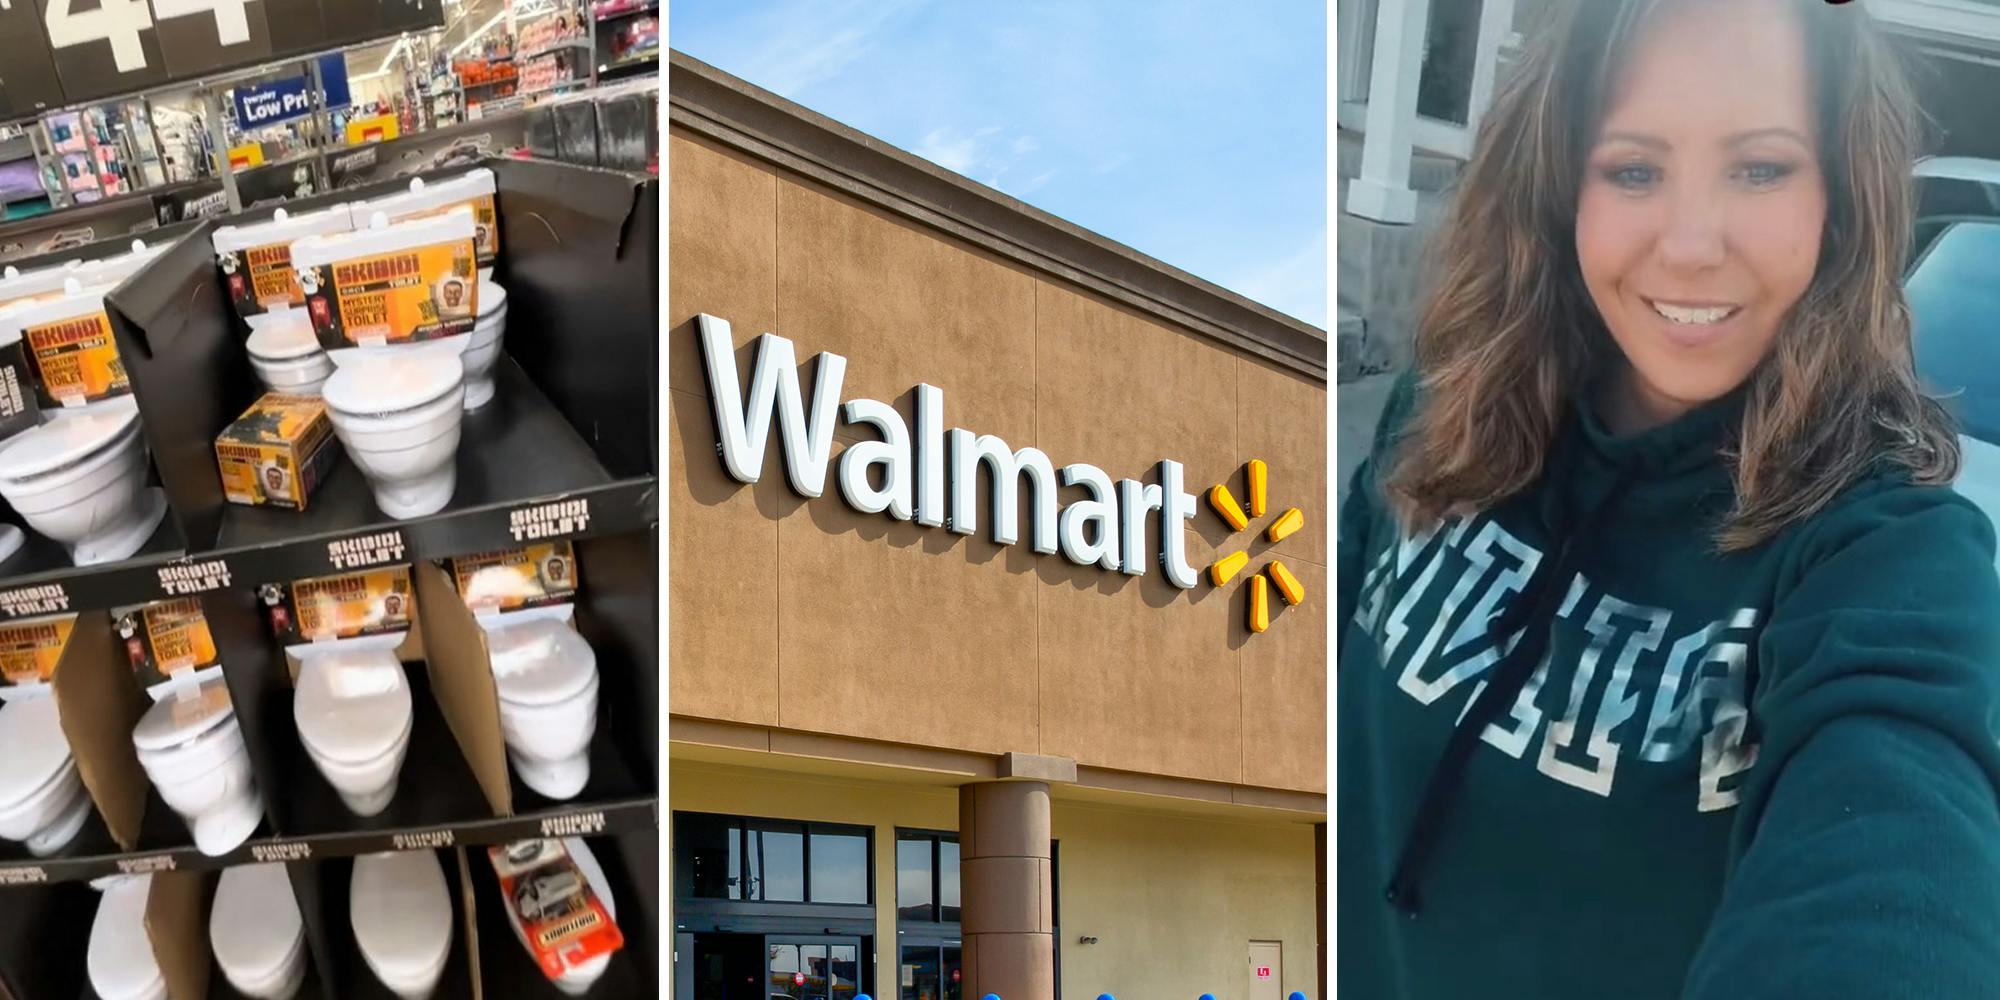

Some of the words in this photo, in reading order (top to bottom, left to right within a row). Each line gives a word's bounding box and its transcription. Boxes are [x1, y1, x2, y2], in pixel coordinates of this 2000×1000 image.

[246, 101, 280, 122] Low
[283, 89, 327, 112] Pri
[249, 245, 291, 266] SKIB
[337, 253, 420, 284] SKIBIDI
[343, 295, 386, 307] MYSTERY
[345, 312, 387, 327] TOILET
[30, 317, 103, 349] SKIBIDI
[49, 371, 84, 387] TOILET
[695, 313, 1198, 589] Walmart
[510, 498, 589, 526] SKIBIDI
[509, 514, 590, 542] TOILET
[327, 530, 402, 556] SKIBIDI
[329, 544, 405, 569] TOILET
[157, 559, 228, 582] SKIBIDI
[161, 573, 232, 596] TOILET
[1, 595, 70, 618] TOILET
[157, 644, 193, 661] TOILET
